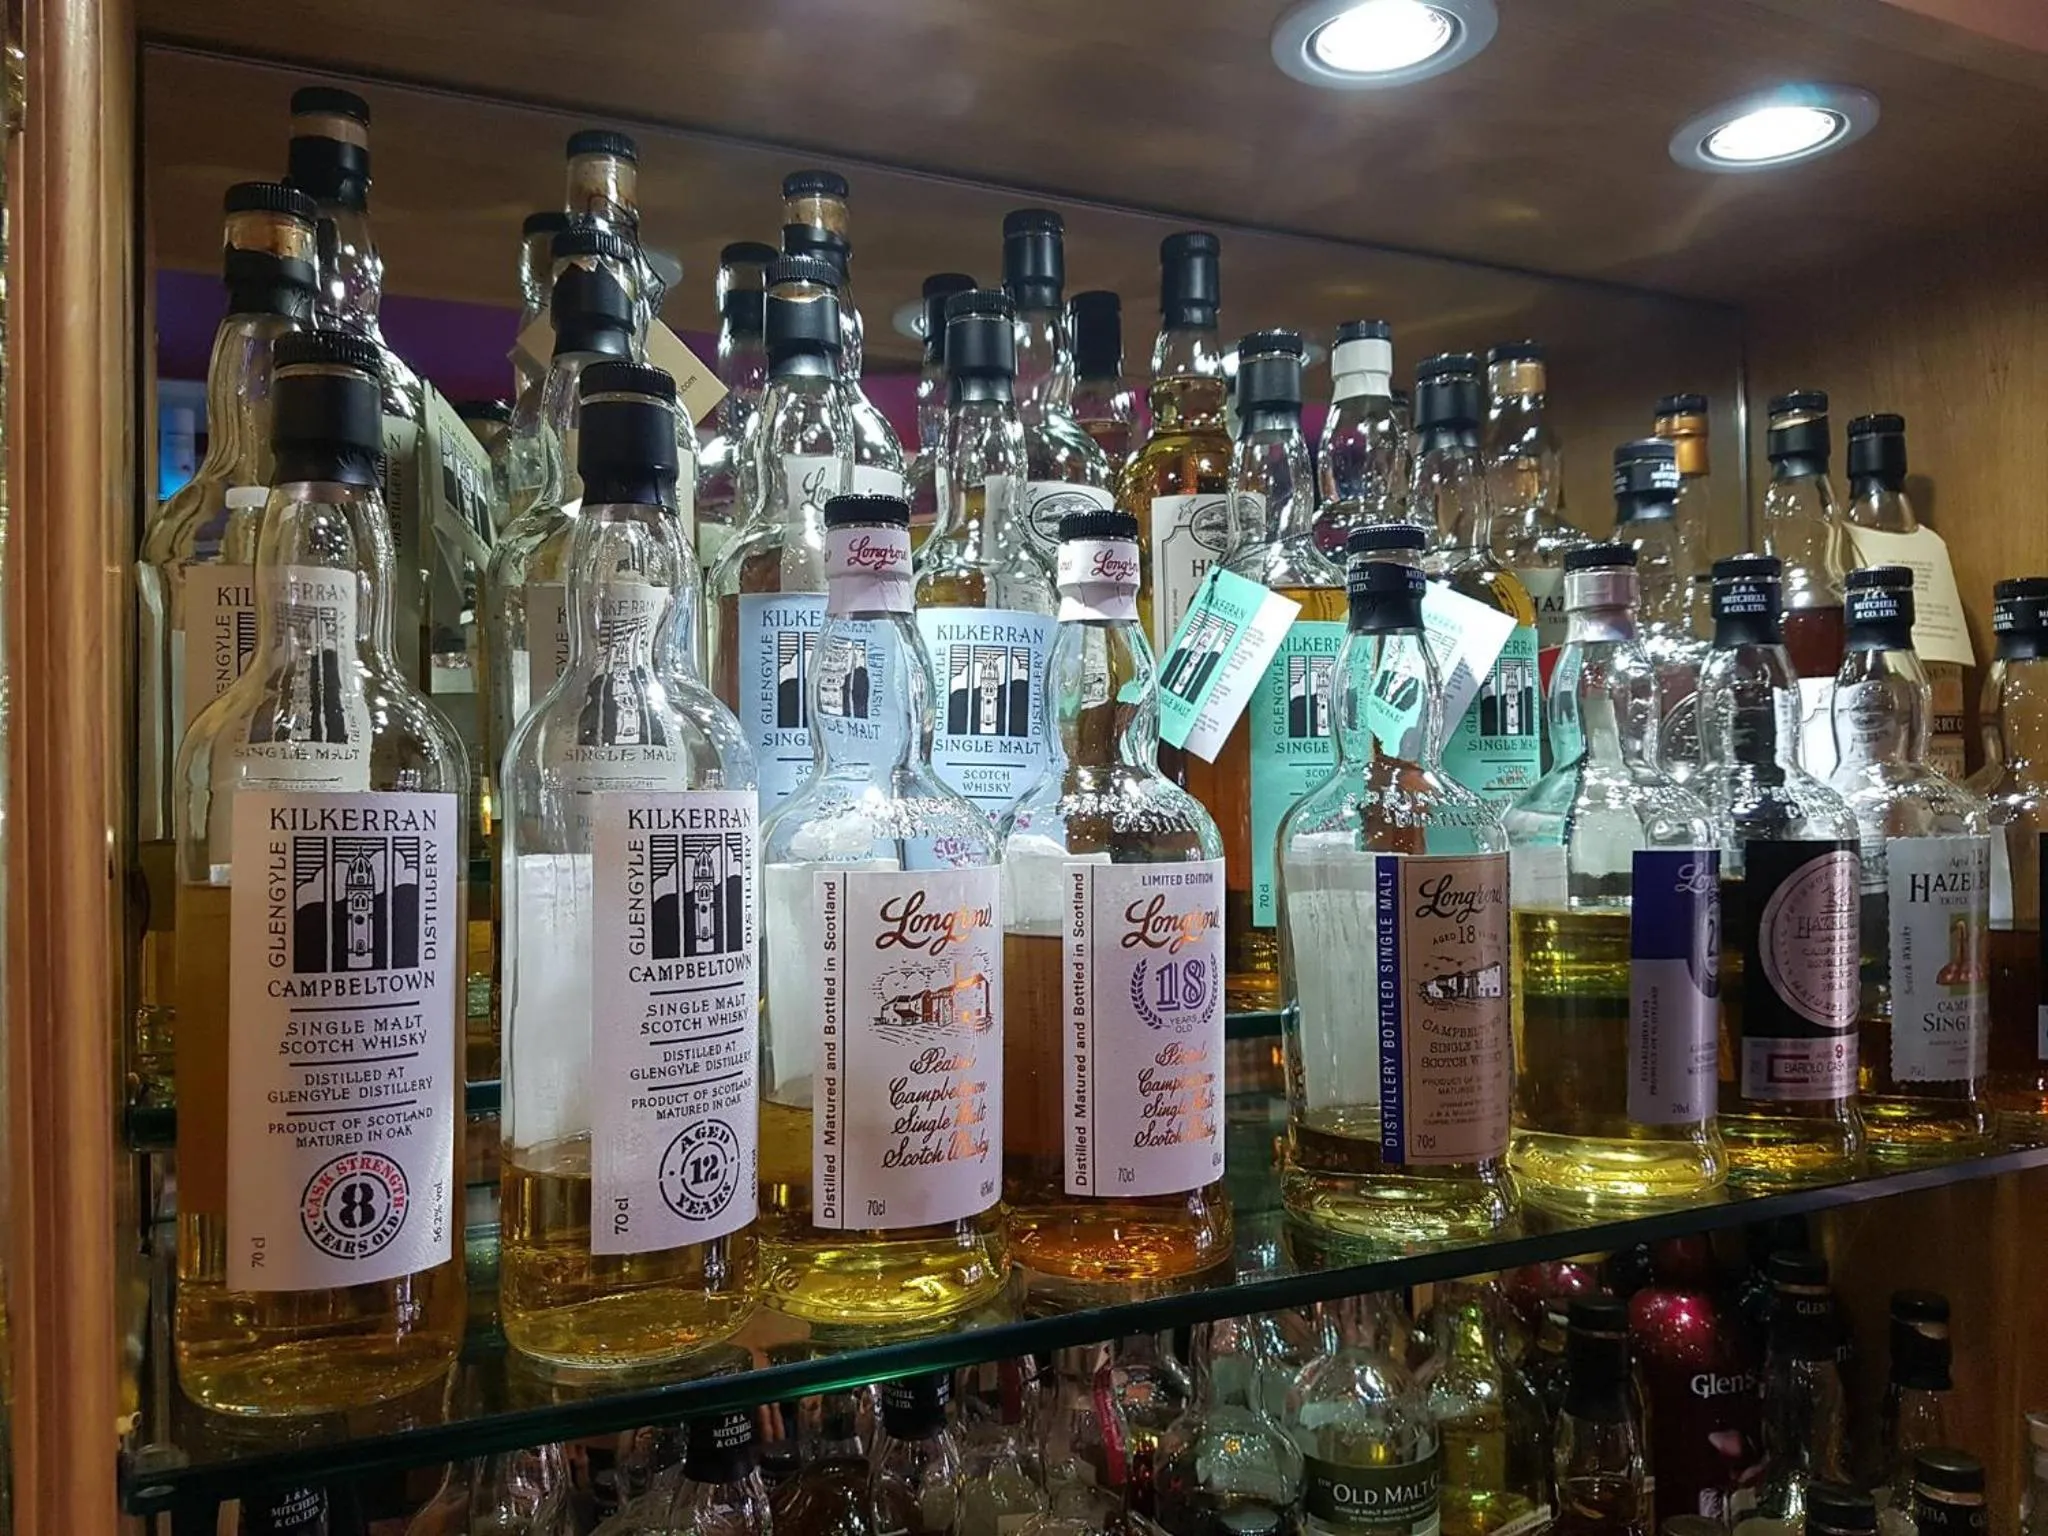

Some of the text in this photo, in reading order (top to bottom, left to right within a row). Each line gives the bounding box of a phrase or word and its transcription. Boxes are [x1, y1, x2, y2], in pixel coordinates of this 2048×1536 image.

[1721, 594, 1768, 604] MITCHELL
[1853, 600, 1899, 611] MITCHELL
[937, 624, 1045, 644] KILKERRAN
[216, 614, 231, 694] ENGYLE
[761, 633, 773, 724] GLENGYLE
[935, 647, 946, 732] GLENGYLE
[1031, 650, 1044, 737] DISTILLERY
[1273, 658, 1285, 736] GLENGYLE
[642, 748, 677, 763] MALT
[934, 738, 1042, 756] SINGLE MALT
[1275, 740, 1330, 755] SINGLE
[1468, 740, 1518, 752] SINGLE
[962, 780, 1012, 793] WHISKY
[963, 769, 1011, 780] SCOTCH
[269, 808, 437, 832] KILKERRAN
[628, 807, 752, 830] KILKERRAN
[744, 835, 753, 945] DISTILLERY
[1141, 872, 1214, 887] LIMITED EDITION
[268, 841, 287, 969] GLENGYLE
[424, 839, 438, 961] DISTILLERY
[628, 838, 645, 956] GLENGYLE
[1432, 932, 1457, 946] AGED
[1457, 924, 1477, 945] 18
[628, 953, 752, 983] CAMPBELTOWN
[267, 970, 436, 999] CAMPBELTOWN
[1154, 958, 1207, 1012] 18
[646, 992, 747, 1018] SINGLE MALT
[1379, 871, 1398, 1147] DISTILLERY BOTTLED SINGLE MALT
[285, 1014, 424, 1037] SINGLE MALT
[640, 1007, 750, 1036] SCOTCH WHISKY
[1072, 872, 1088, 1186] Distilled Matured and Bottled in Scotland
[1169, 1014, 1197, 1025] YEARS
[1175, 1024, 1193, 1034] OLD
[278, 1030, 428, 1056] SCOTCH WHISKY
[663, 1040, 737, 1063] DISTILLED AT
[823, 880, 837, 1219] Distilled Matured and Bottled in Scotland
[1429, 1040, 1472, 1054] SINGLE
[629, 1049, 752, 1081] GLENGYLE DISTILLERY
[1420, 1055, 1467, 1069] SCOTCH
[1784, 1061, 1823, 1073] BAROLO
[267, 1075, 434, 1104] GLENGYLE DISTILLERY
[304, 1066, 406, 1087] DISTILLED AT
[631, 1076, 753, 1110] PRODUCT OF SCOTLAND
[267, 1106, 434, 1135] PRODUCT OF SCOTLAND
[656, 1099, 710, 1121] MATURED
[712, 1098, 724, 1111] IN
[890, 1103, 951, 1144] Single
[296, 1124, 414, 1149] MATURED IN OAK
[679, 1123, 731, 1154] AGED
[1132, 1120, 1182, 1148] Scotch
[881, 1135, 944, 1169] Scotch
[688, 1153, 720, 1186] 12
[305, 1156, 406, 1220] CASK STRENGTH
[674, 1180, 733, 1215] YEARS
[338, 1181, 377, 1229] 8
[312, 1214, 401, 1254] YEARS OLD
[712, 1420, 752, 1438] MITCHELL
[1332, 1482, 1379, 1505] OLD
[1384, 1480, 1429, 1505] MALT
